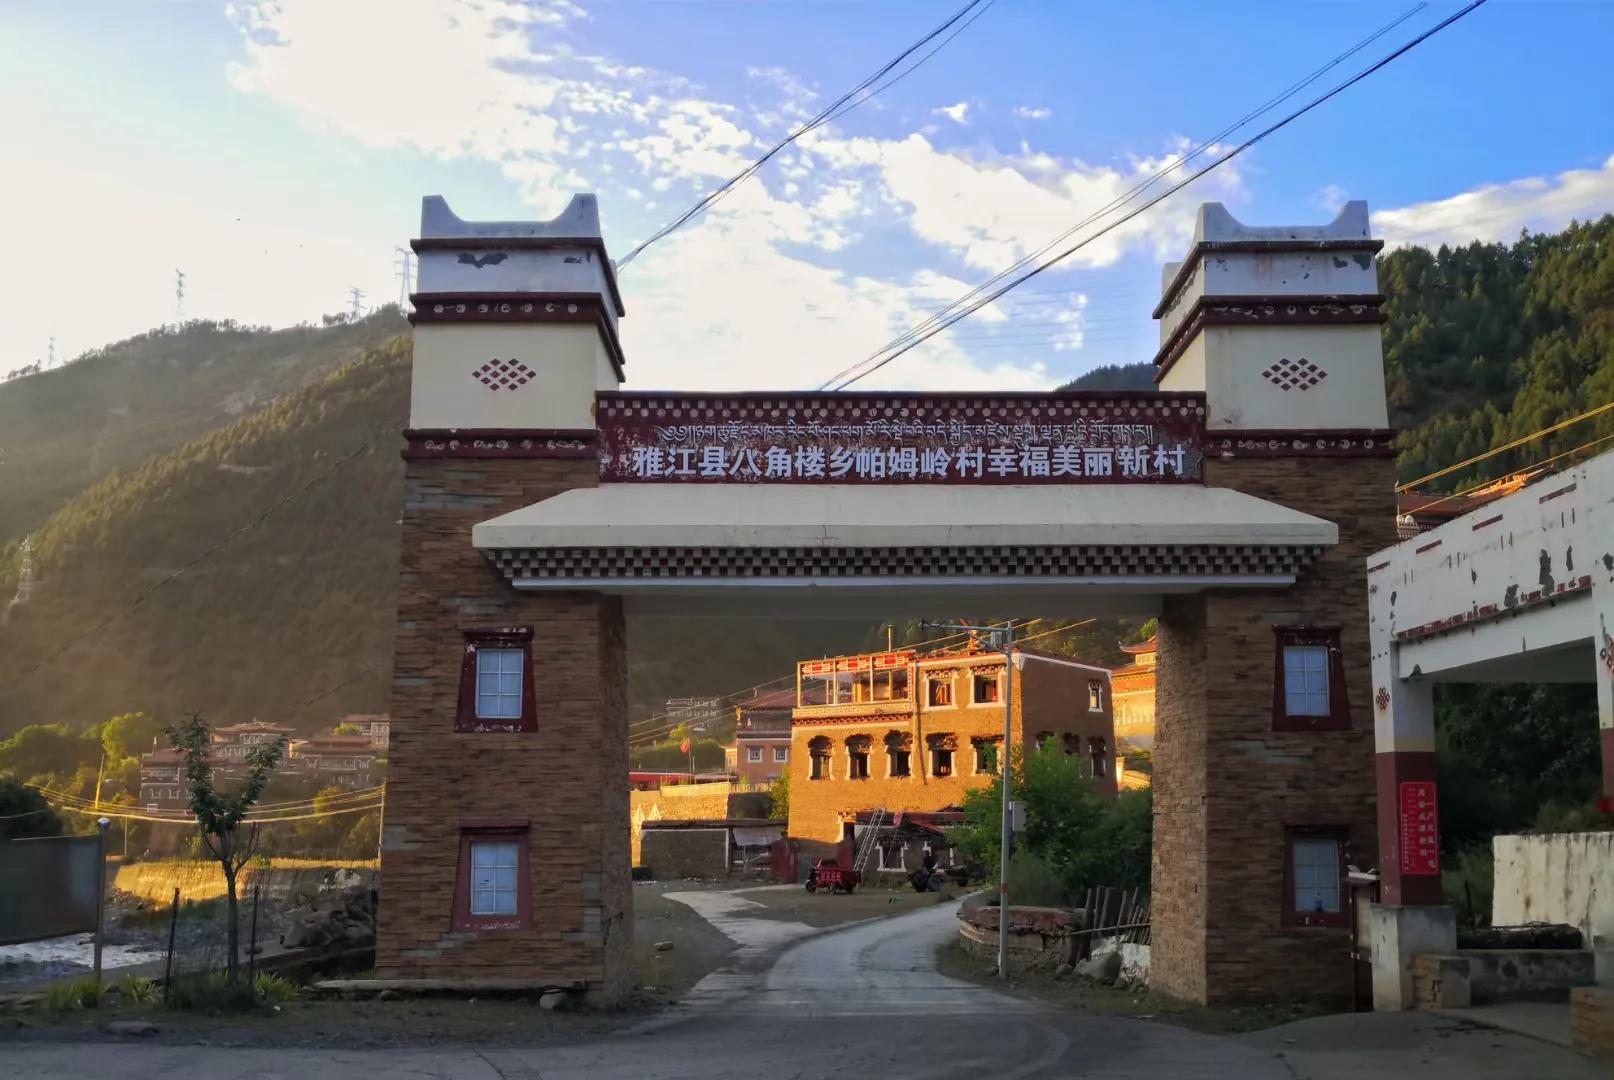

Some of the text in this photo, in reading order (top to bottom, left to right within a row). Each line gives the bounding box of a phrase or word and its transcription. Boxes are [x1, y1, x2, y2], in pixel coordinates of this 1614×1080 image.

[632, 444, 1186, 478] 雅江县八角楼乡帕姆岭村幸福美丽新村
